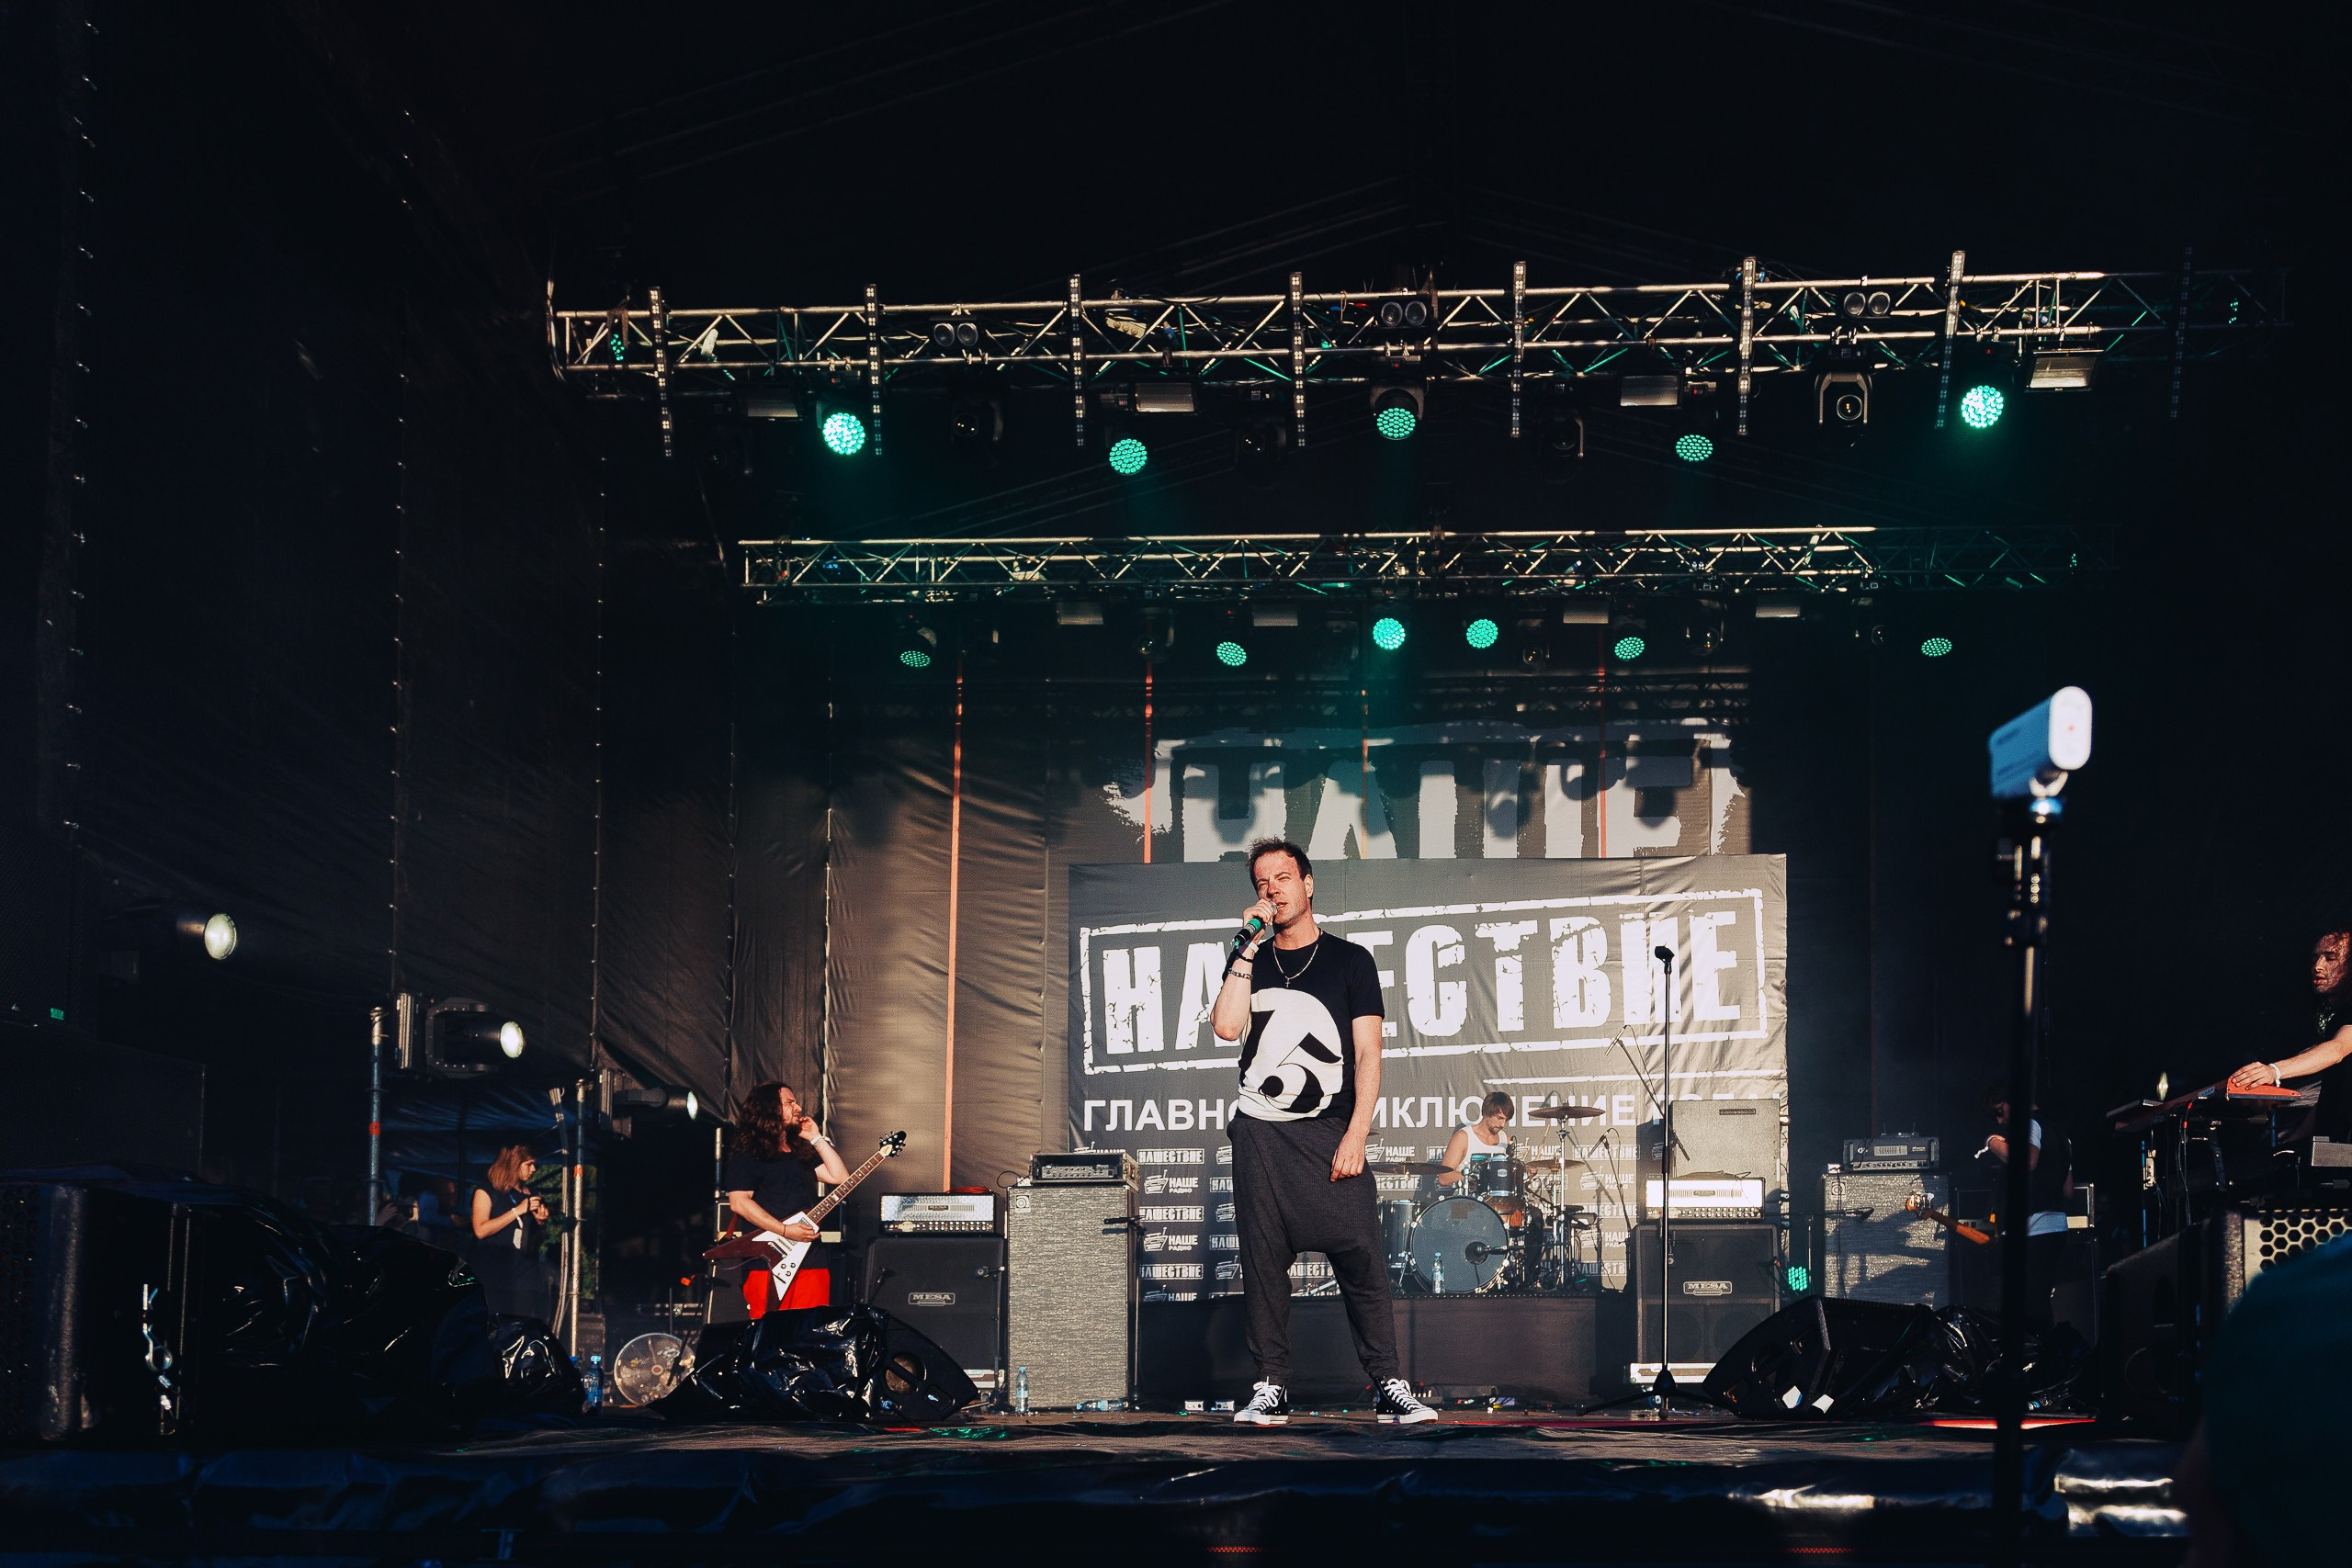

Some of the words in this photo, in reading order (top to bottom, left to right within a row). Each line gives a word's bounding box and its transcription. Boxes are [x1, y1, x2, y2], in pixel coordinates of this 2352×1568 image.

[1102, 911, 1740, 1055] НАЕСТВИЕ
[1083, 1099, 1238, 1132] ГЛАВН
[1370, 1094, 1636, 1128] ИКЛЮЕНИЕ
[1138, 1150, 1203, 1163] НАШЕСТВИЕ
[1385, 1145, 1415, 1157] НАШЕ
[1169, 1177, 1199, 1188] НАШЕ
[1168, 1235, 1198, 1246] НАШЕ
